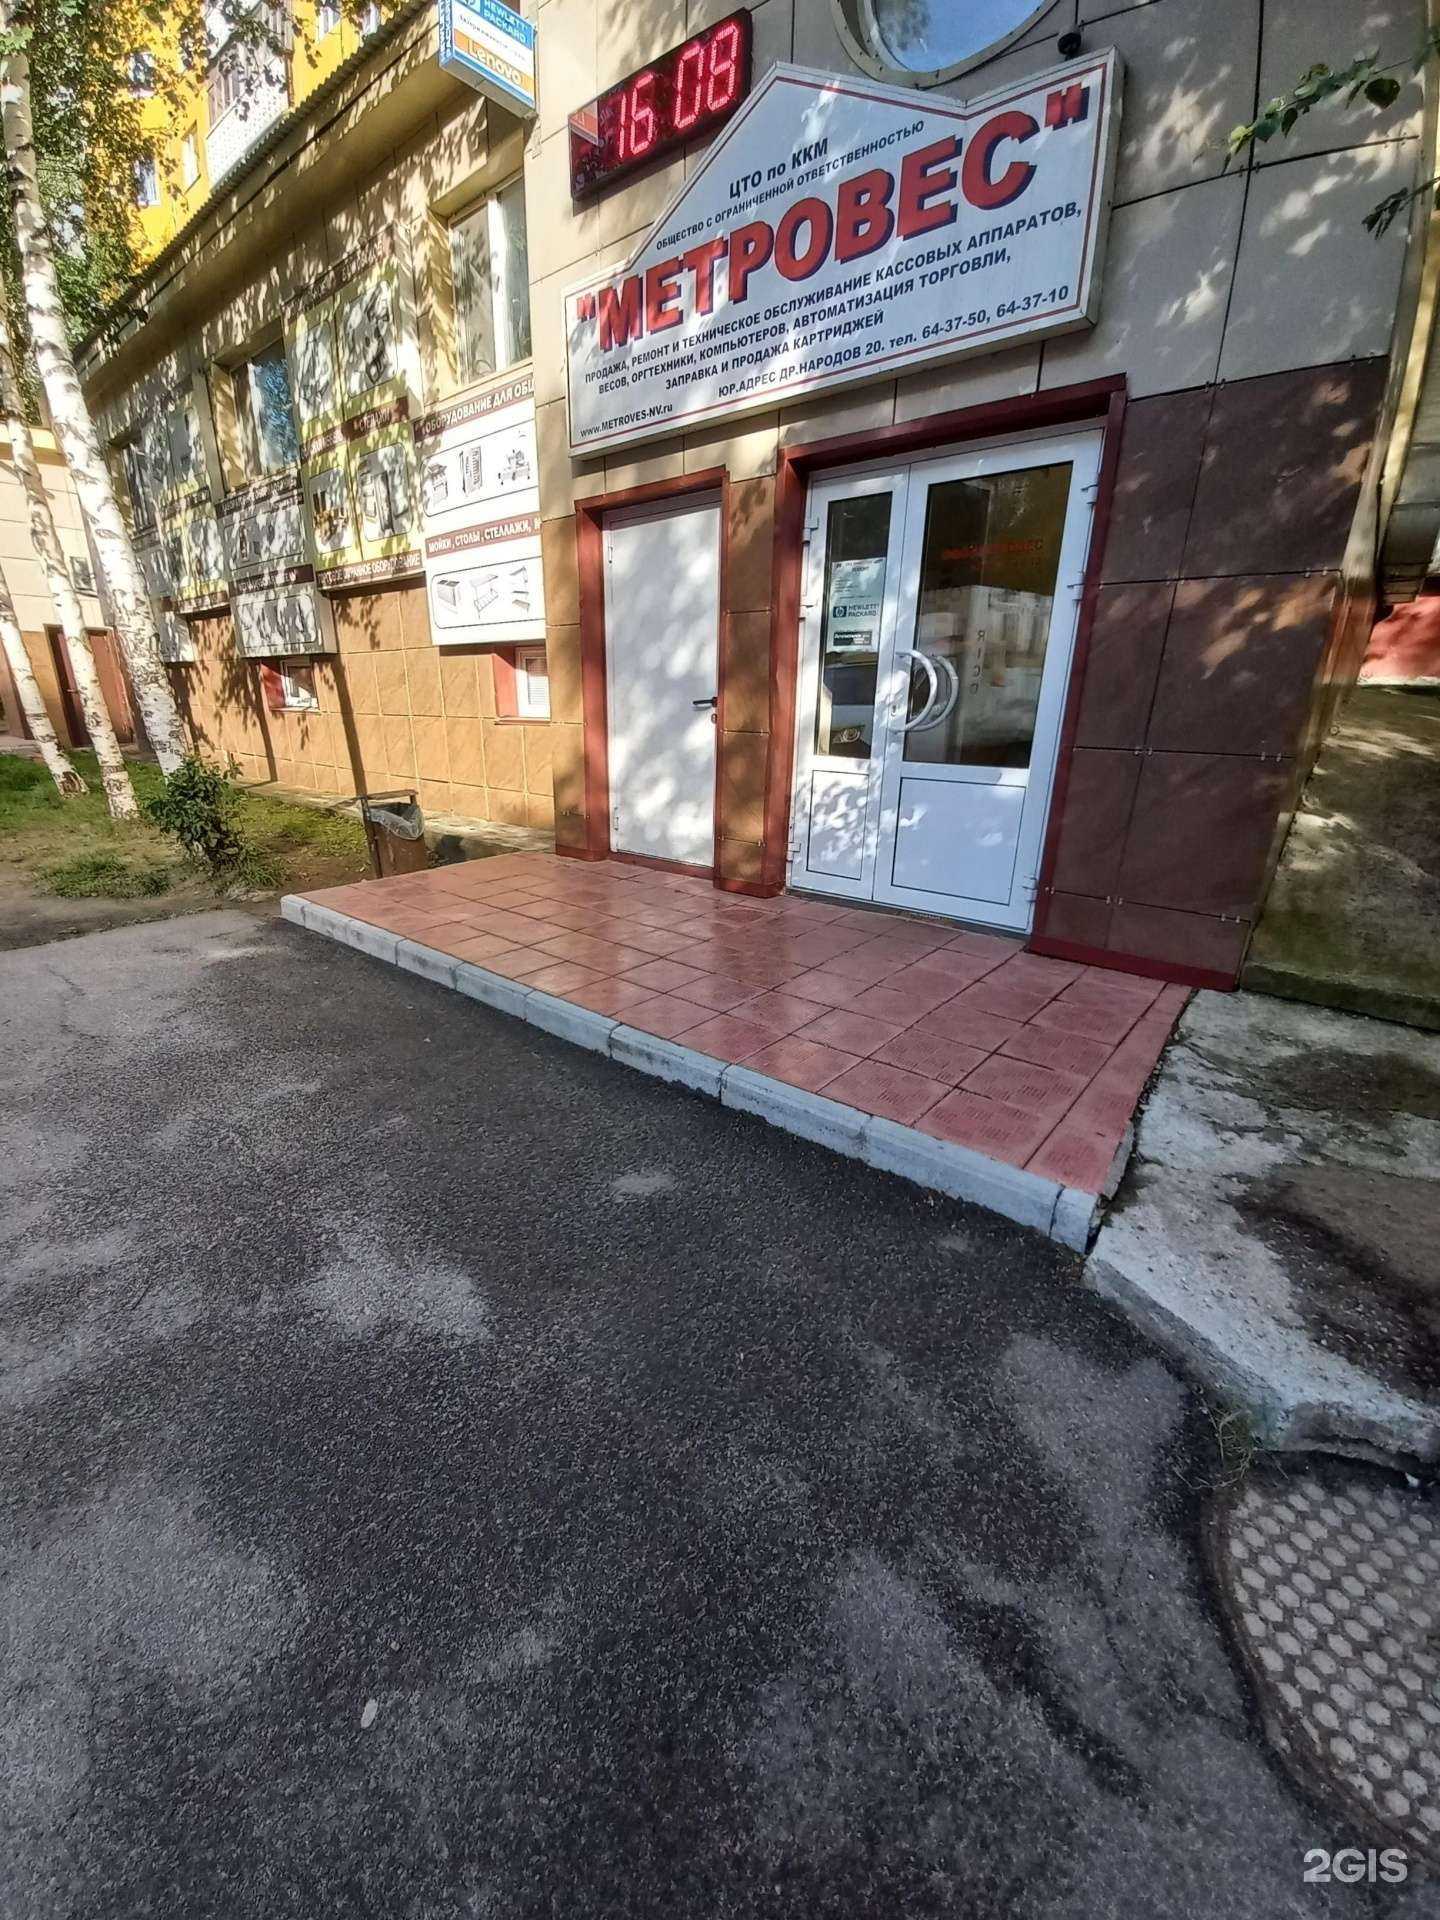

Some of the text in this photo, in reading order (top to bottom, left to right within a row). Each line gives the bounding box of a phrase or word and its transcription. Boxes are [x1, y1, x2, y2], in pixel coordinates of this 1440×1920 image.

[468, 40, 521, 85] Lenovo
[483, 10, 527, 43] PACKARD
[618, 72, 655, 158] 16
[656, 220, 704, 251] ОБЩЕСТВО
[714, 177, 794, 224] ОГРАНИЧЕННОЙ
[796, 120, 925, 187] ОТВЕТСТВЕННОСТЬЮ
[729, 138, 829, 200] ЦТО по ККМ
[585, 201, 1082, 384] ПРОДАЖА, РЕМОНТ И ТЕХНИЧЕСКОЕ ОБСЛУЖИВАНИЕ КАССОВЫХ АППАРАТОВ,
[599, 248, 1012, 394] ВЕСОВ, ОРГТЕХНИКИ, КОМПЬЮТЕРОВ, АВТОМАТИЗАЦИЯ ТОРГОВЛИ,
[665, 308, 884, 391] ЗАПРАВКА И ПРОДАЖА КАРТРИДЖЕЙ
[718, 285, 1069, 398] ЮР.АДРЕС ДР.НАРОДОВ 20. тел. 64-37-50, 64-37-10
[425, 396, 492, 433] ОБОРУДОВАНИЕ
[493, 387, 513, 407] ДЛЯ
[580, 403, 673, 438] www.METROVES-NV.ru
